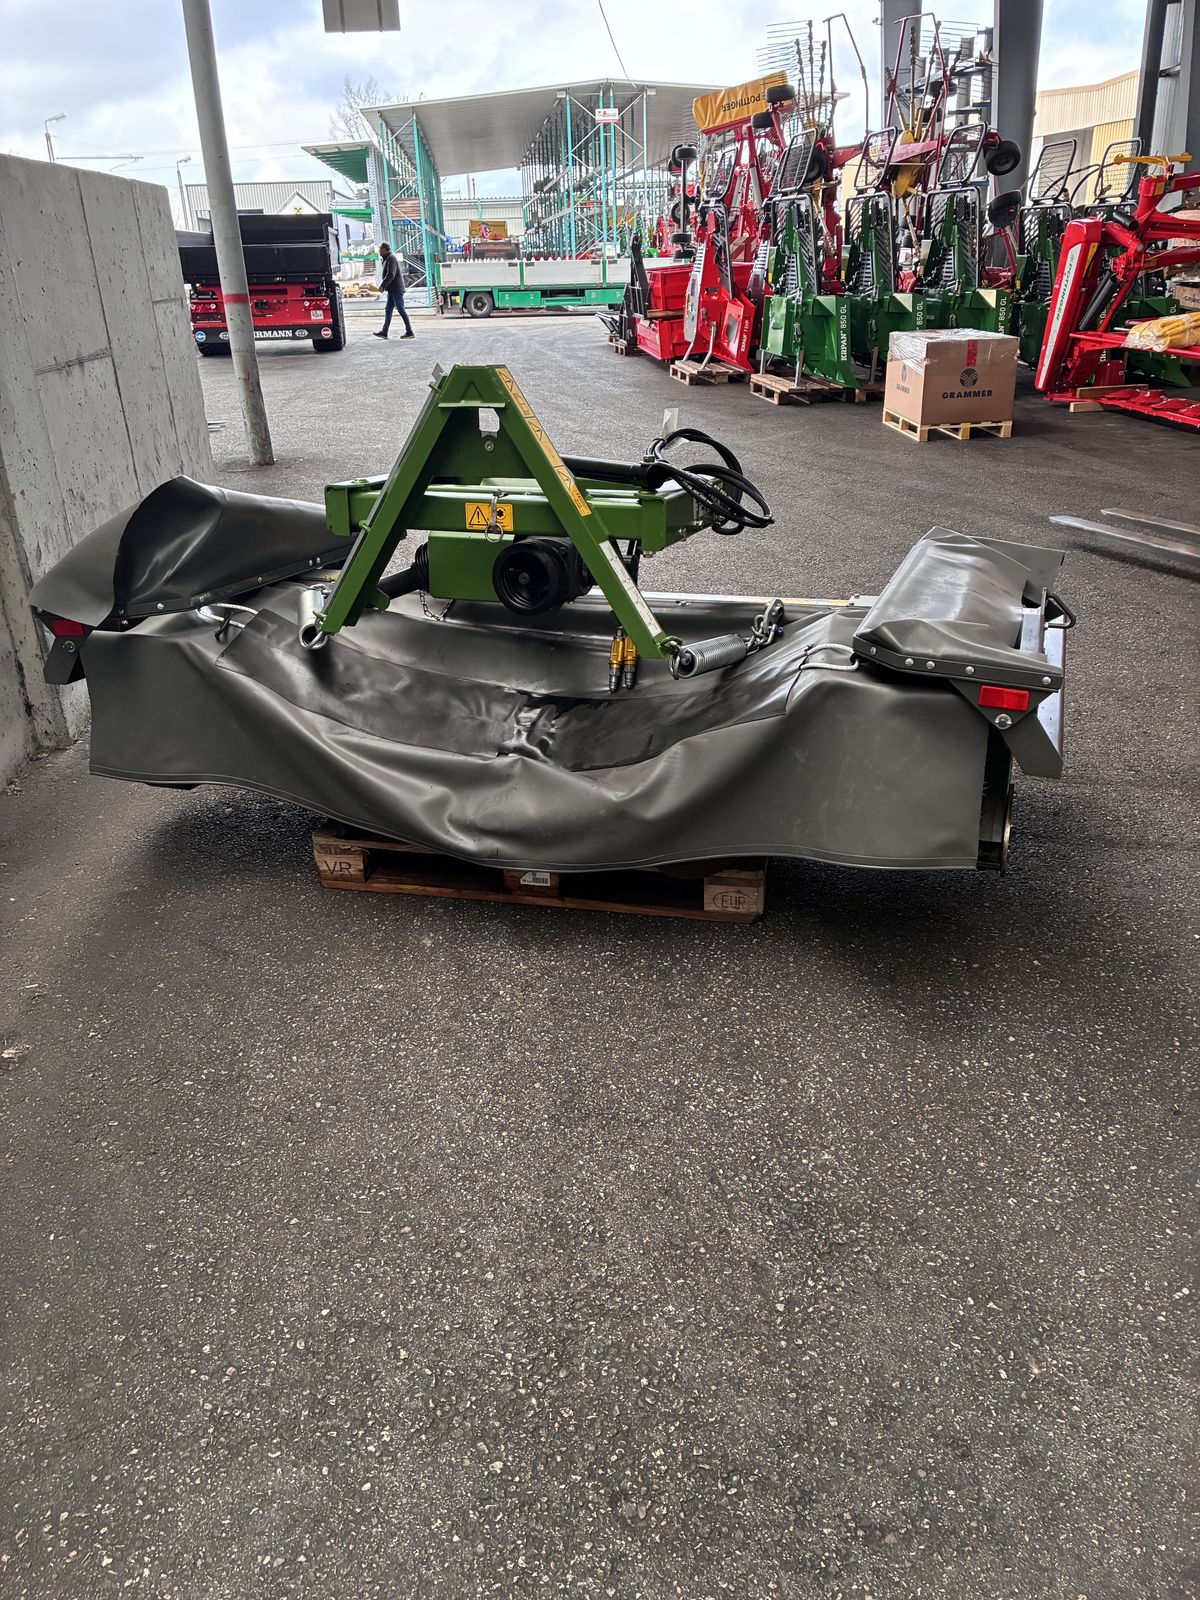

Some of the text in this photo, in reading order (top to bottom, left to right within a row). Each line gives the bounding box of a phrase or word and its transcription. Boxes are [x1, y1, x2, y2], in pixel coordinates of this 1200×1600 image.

[917, 301, 923, 310] GL
[1000, 296, 1007, 306] GL
[840, 304, 847, 314] GL
[942, 389, 993, 399] GRAMMER
[324, 860, 352, 875] VR
